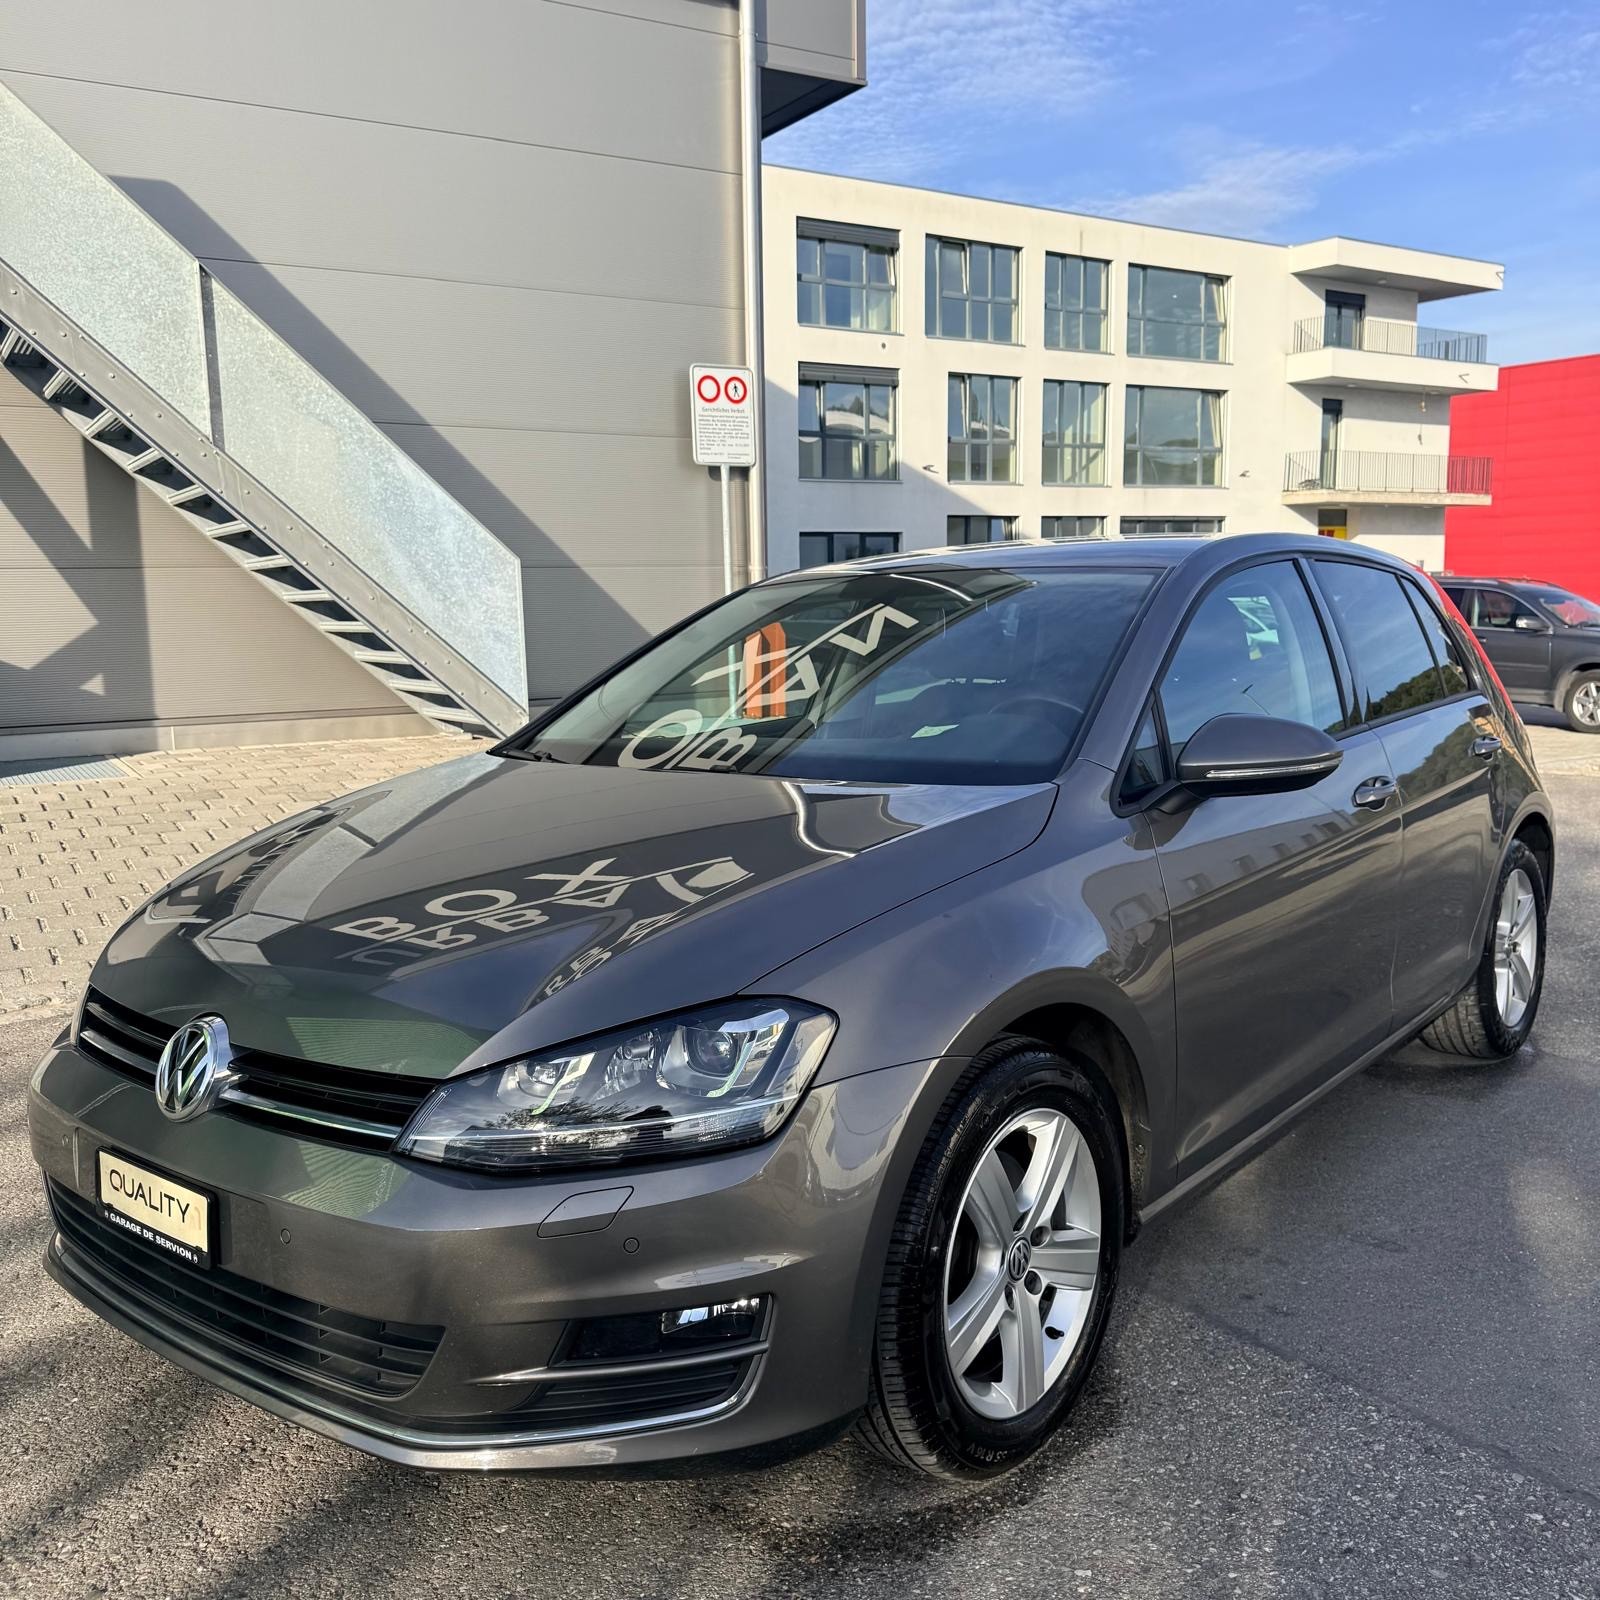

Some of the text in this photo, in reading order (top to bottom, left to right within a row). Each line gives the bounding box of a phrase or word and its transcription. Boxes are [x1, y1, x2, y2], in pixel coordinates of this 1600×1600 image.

[109, 1169, 190, 1223] QUALITY
[110, 1213, 192, 1261] GARAGE DE SERVION
